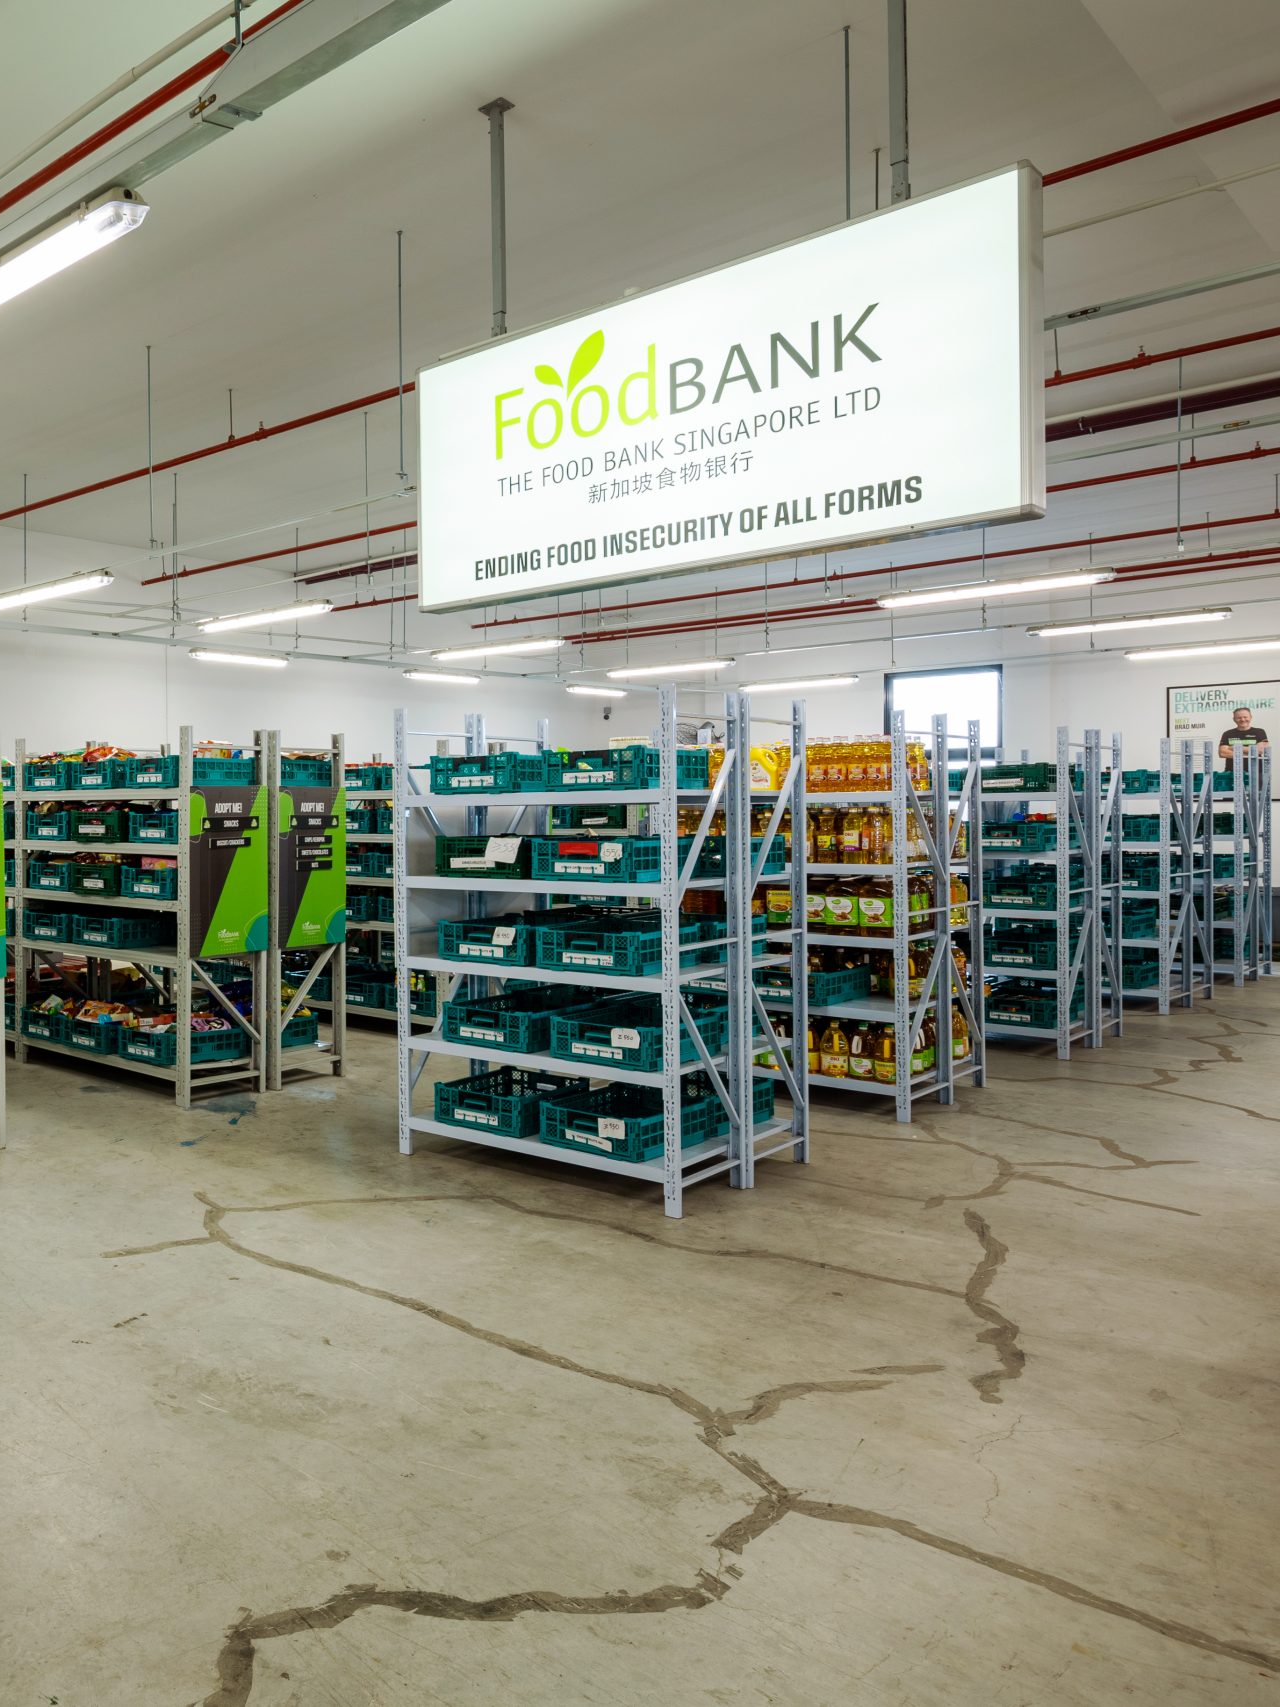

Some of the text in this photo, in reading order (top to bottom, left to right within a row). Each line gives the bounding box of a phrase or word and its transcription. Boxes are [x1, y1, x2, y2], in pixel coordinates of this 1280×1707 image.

[497, 386, 882, 498] THE FOOD BANK SINGAPORE LTD
[588, 451, 754, 504] 新加坡食物银行
[475, 475, 922, 581] ENDING FOOD INSECURITY OF ALL FORMS
[1174, 689, 1229, 703] DELIVERY
[1174, 698, 1276, 714] EXTRAORDINAIRE
[214, 802, 231, 814] ADOPT
[300, 802, 315, 813] ADOPT
